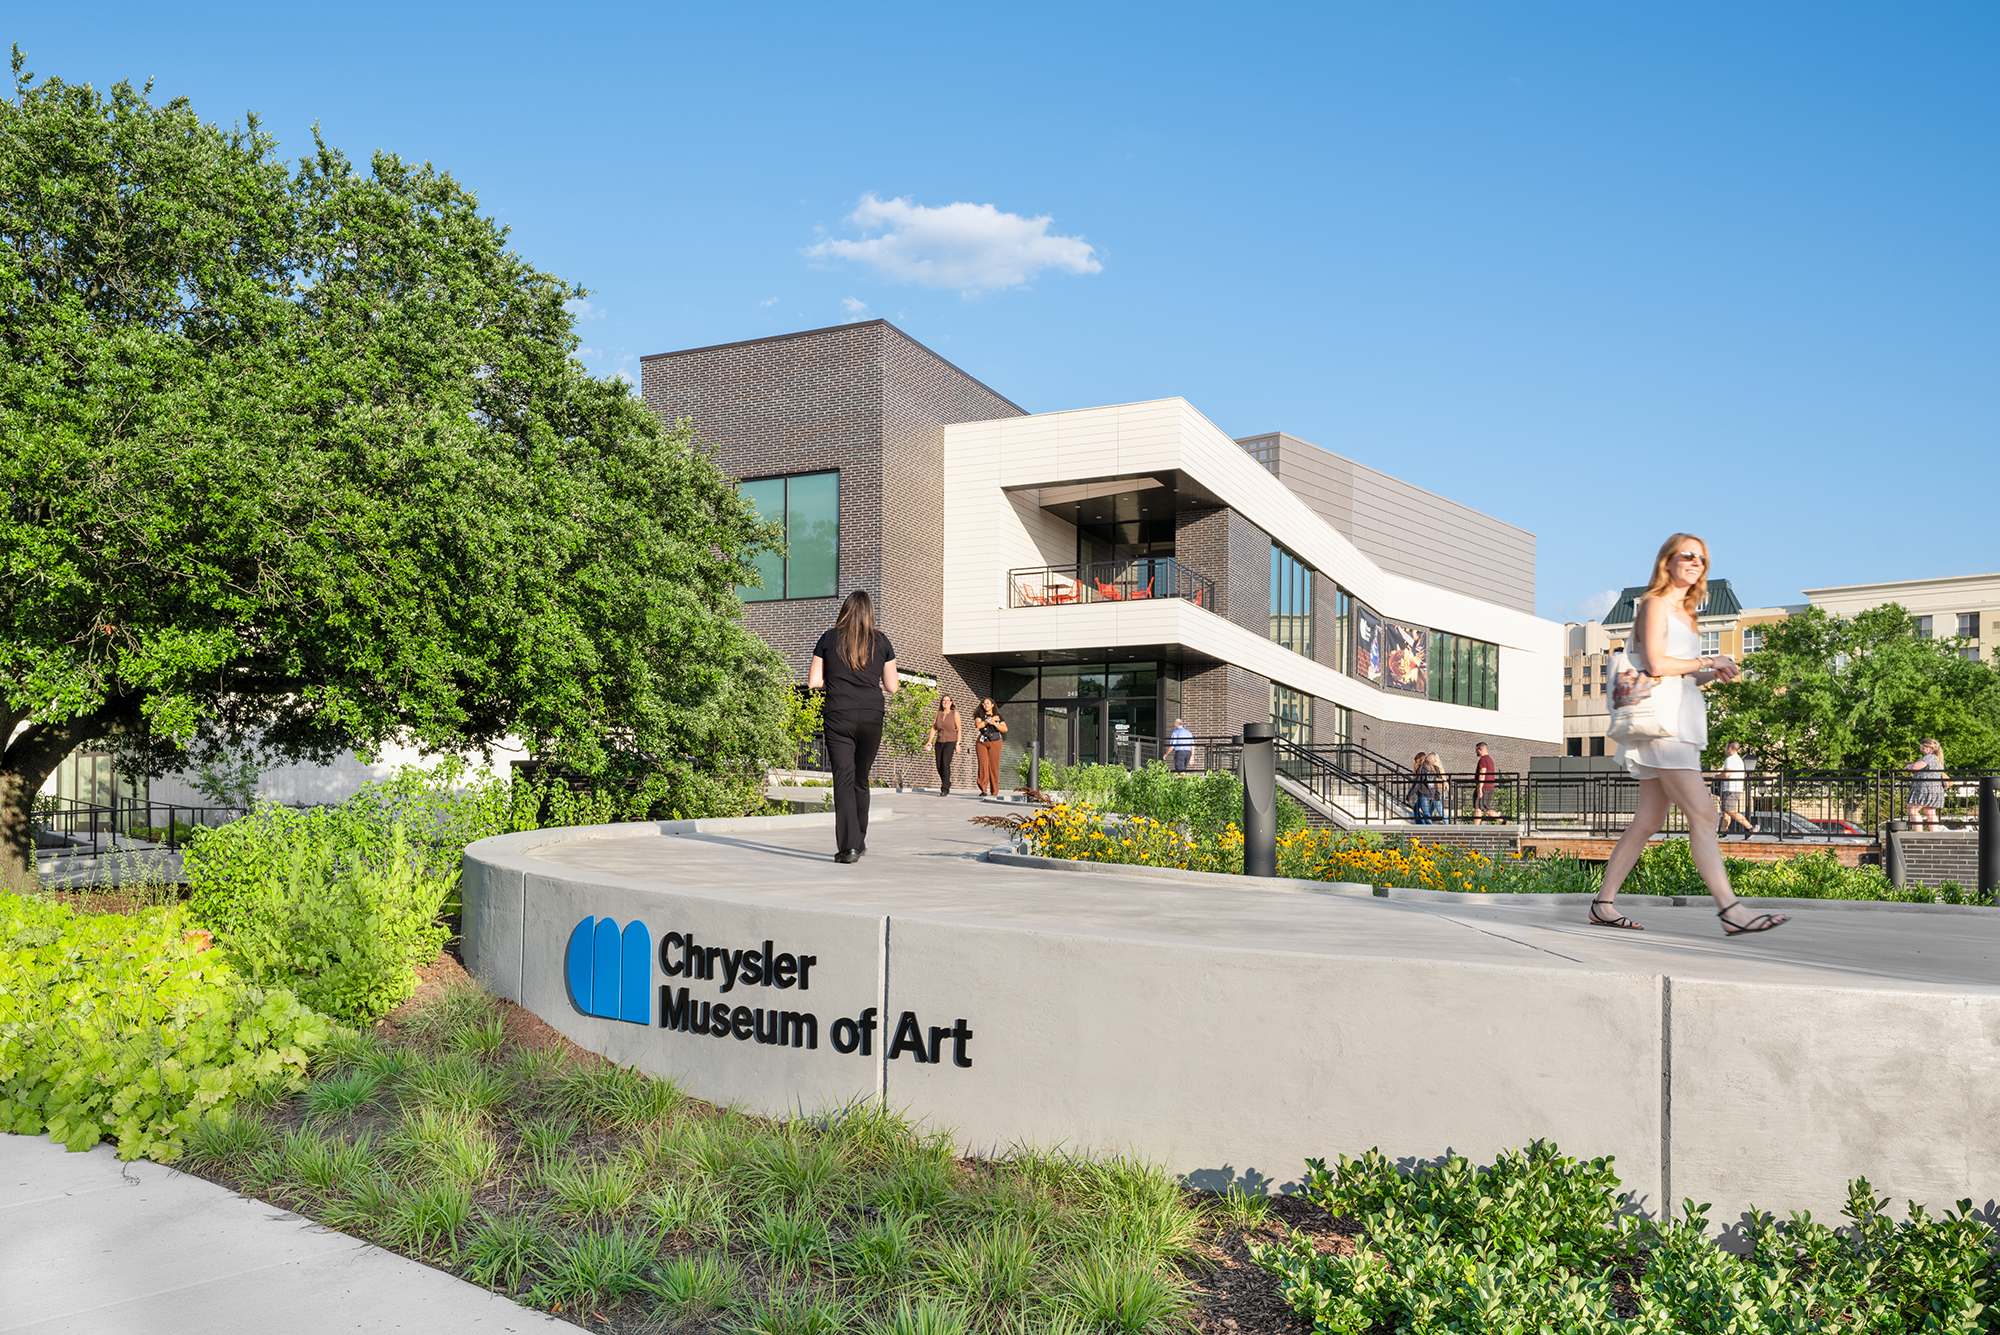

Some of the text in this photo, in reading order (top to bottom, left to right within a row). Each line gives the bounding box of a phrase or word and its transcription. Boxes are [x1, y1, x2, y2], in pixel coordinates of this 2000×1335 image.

[659, 932, 817, 993] Chrysler
[659, 985, 973, 1068] Museum of Art
